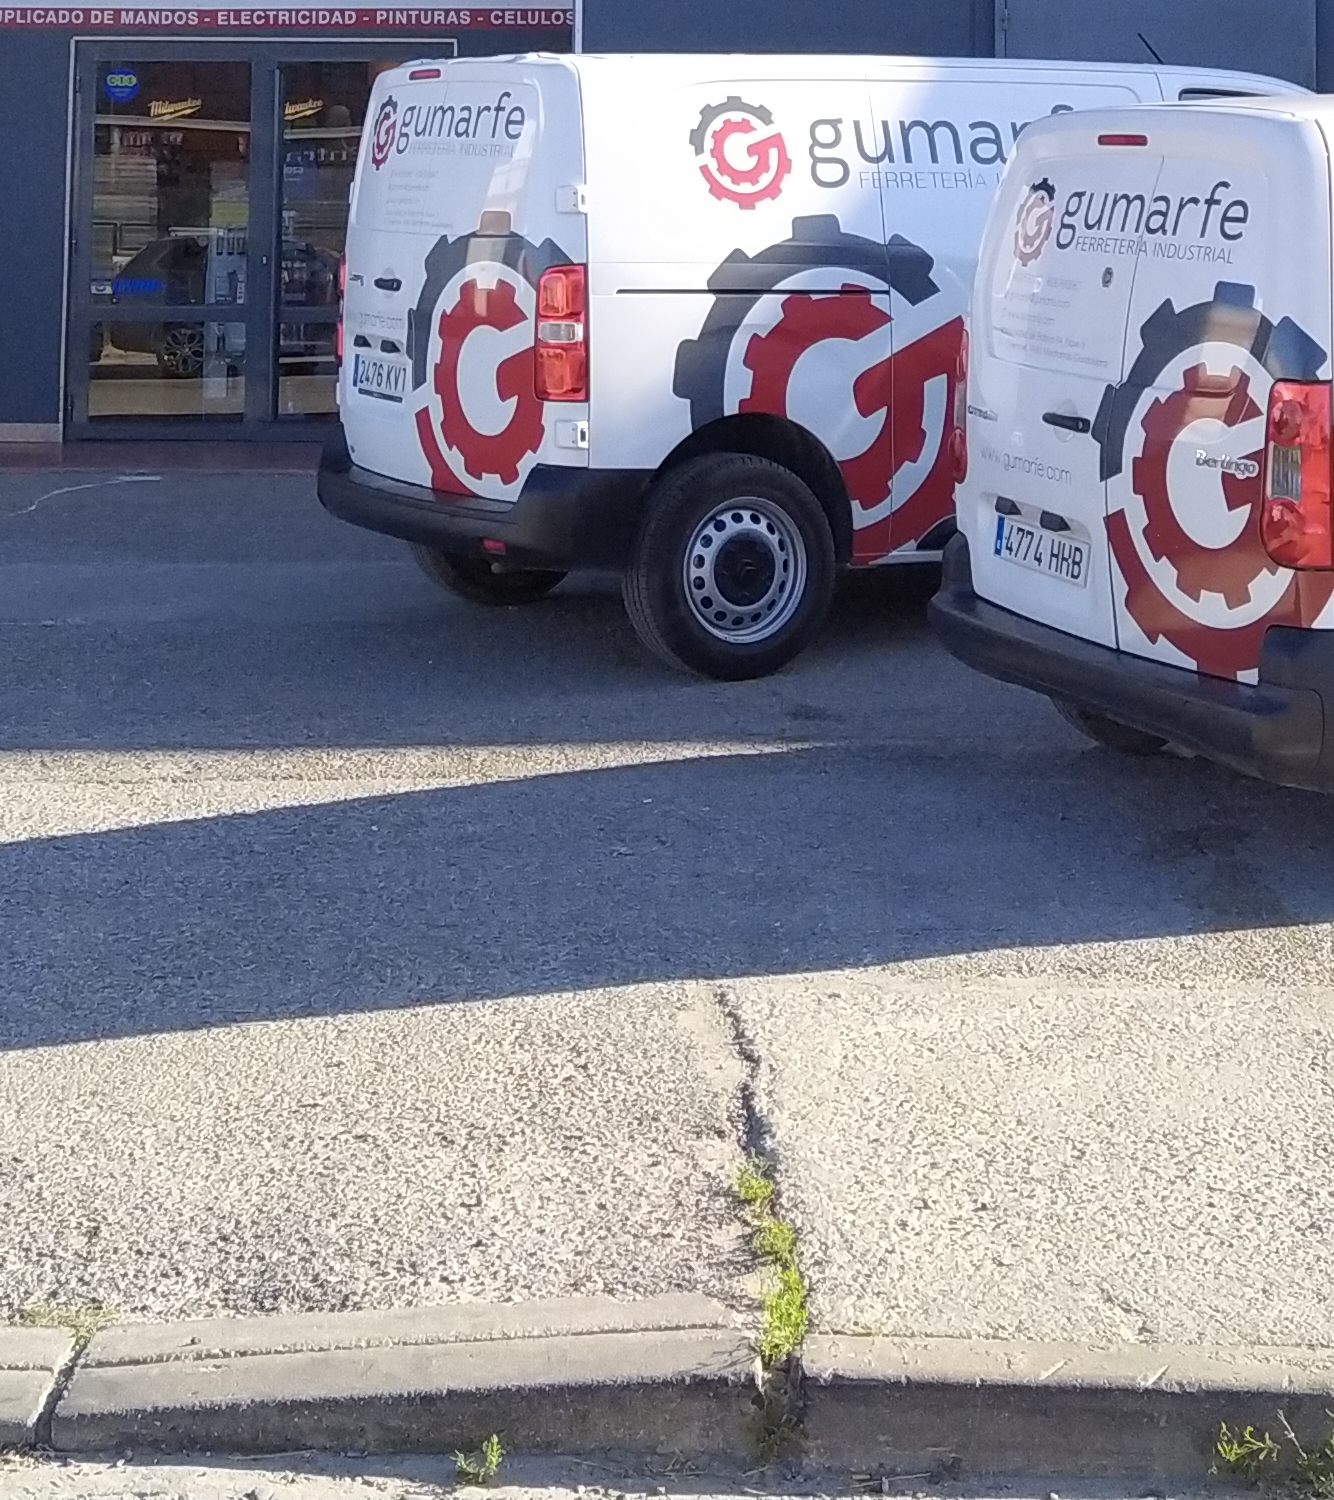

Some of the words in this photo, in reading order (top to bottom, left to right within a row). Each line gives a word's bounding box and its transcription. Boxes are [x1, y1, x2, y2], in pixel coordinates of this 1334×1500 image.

[90, 10, 114, 24] DE
[120, 11, 199, 25] MANDOS
[217, 11, 357, 25] ELECTRICIDAD
[376, 11, 471, 25] PINTURAS
[396, 91, 525, 155] gumarfe
[859, 168, 987, 190] FERRETERÍA
[1056, 180, 1249, 250] gumarfe
[1153, 242, 1234, 264] INDUSTRIAL
[1195, 450, 1257, 478] Berlingo
[1004, 524, 1044, 567] 4774
